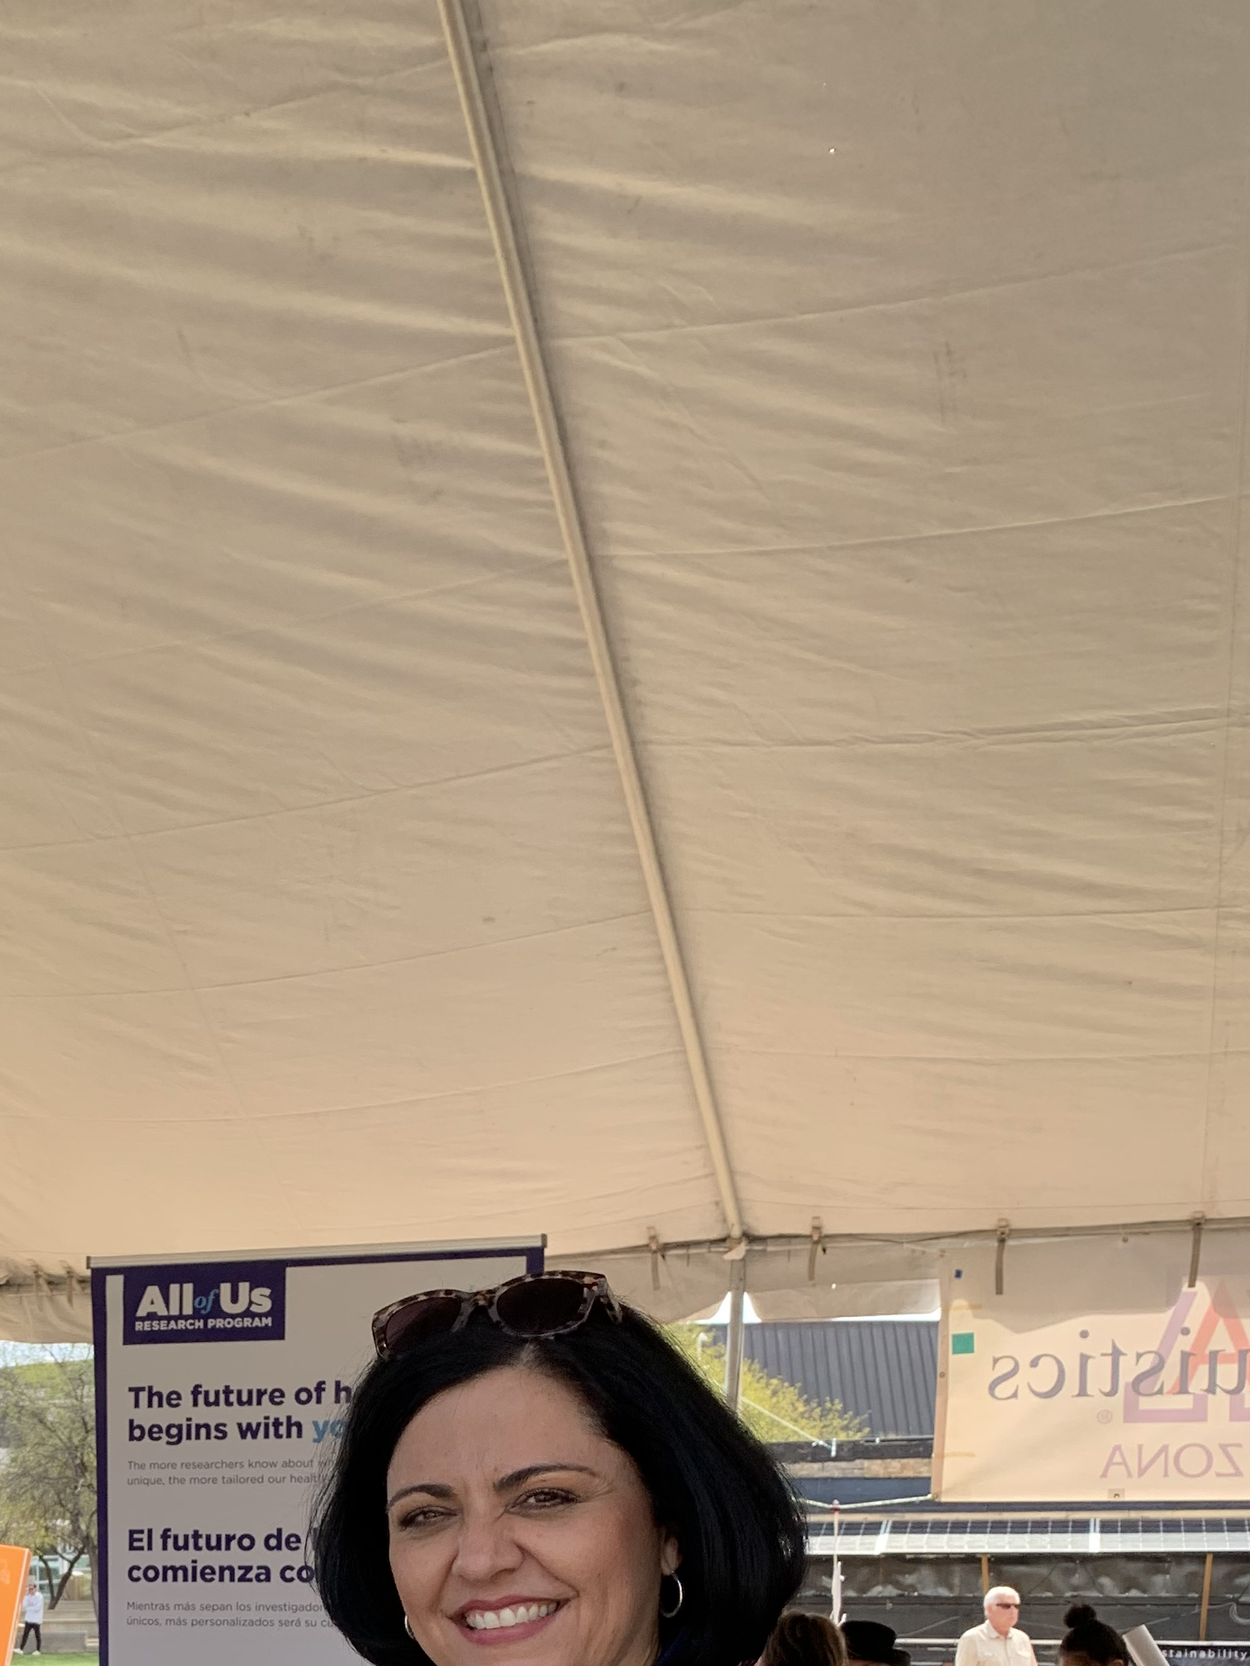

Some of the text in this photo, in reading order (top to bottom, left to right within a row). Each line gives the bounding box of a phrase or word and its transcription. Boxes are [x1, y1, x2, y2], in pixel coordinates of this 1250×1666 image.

[135, 1282, 273, 1317] All of Us
[135, 1317, 273, 1332] RESEARCH PROGRAM
[128, 1385, 183, 1409] The
[191, 1384, 286, 1408] future
[294, 1380, 327, 1405] of
[128, 1415, 348, 1446] begins with yo
[127, 1460, 147, 1470] The
[149, 1462, 179, 1470] more
[180, 1459, 245, 1470] researchers
[248, 1459, 278, 1469] know
[281, 1459, 314, 1469] about
[127, 1475, 166, 1486] unique,
[168, 1475, 187, 1485] the
[189, 1477, 219, 1485] more
[221, 1474, 265, 1485] tailored
[267, 1476, 287, 1484] our
[128, 1528, 153, 1551] El
[160, 1528, 256, 1551] futuro
[263, 1527, 301, 1551] de
[127, 1559, 272, 1582] comienza
[126, 1601, 171, 1612] Mientras
[173, 1601, 197, 1612] más
[199, 1603, 233, 1614] sepan
[235, 1602, 252, 1612] los
[126, 1616, 163, 1627] únicos,
[165, 1616, 188, 1627] más
[190, 1616, 275, 1628] personalizados
[277, 1617, 301, 1627] será
[304, 1619, 318, 1628] su
